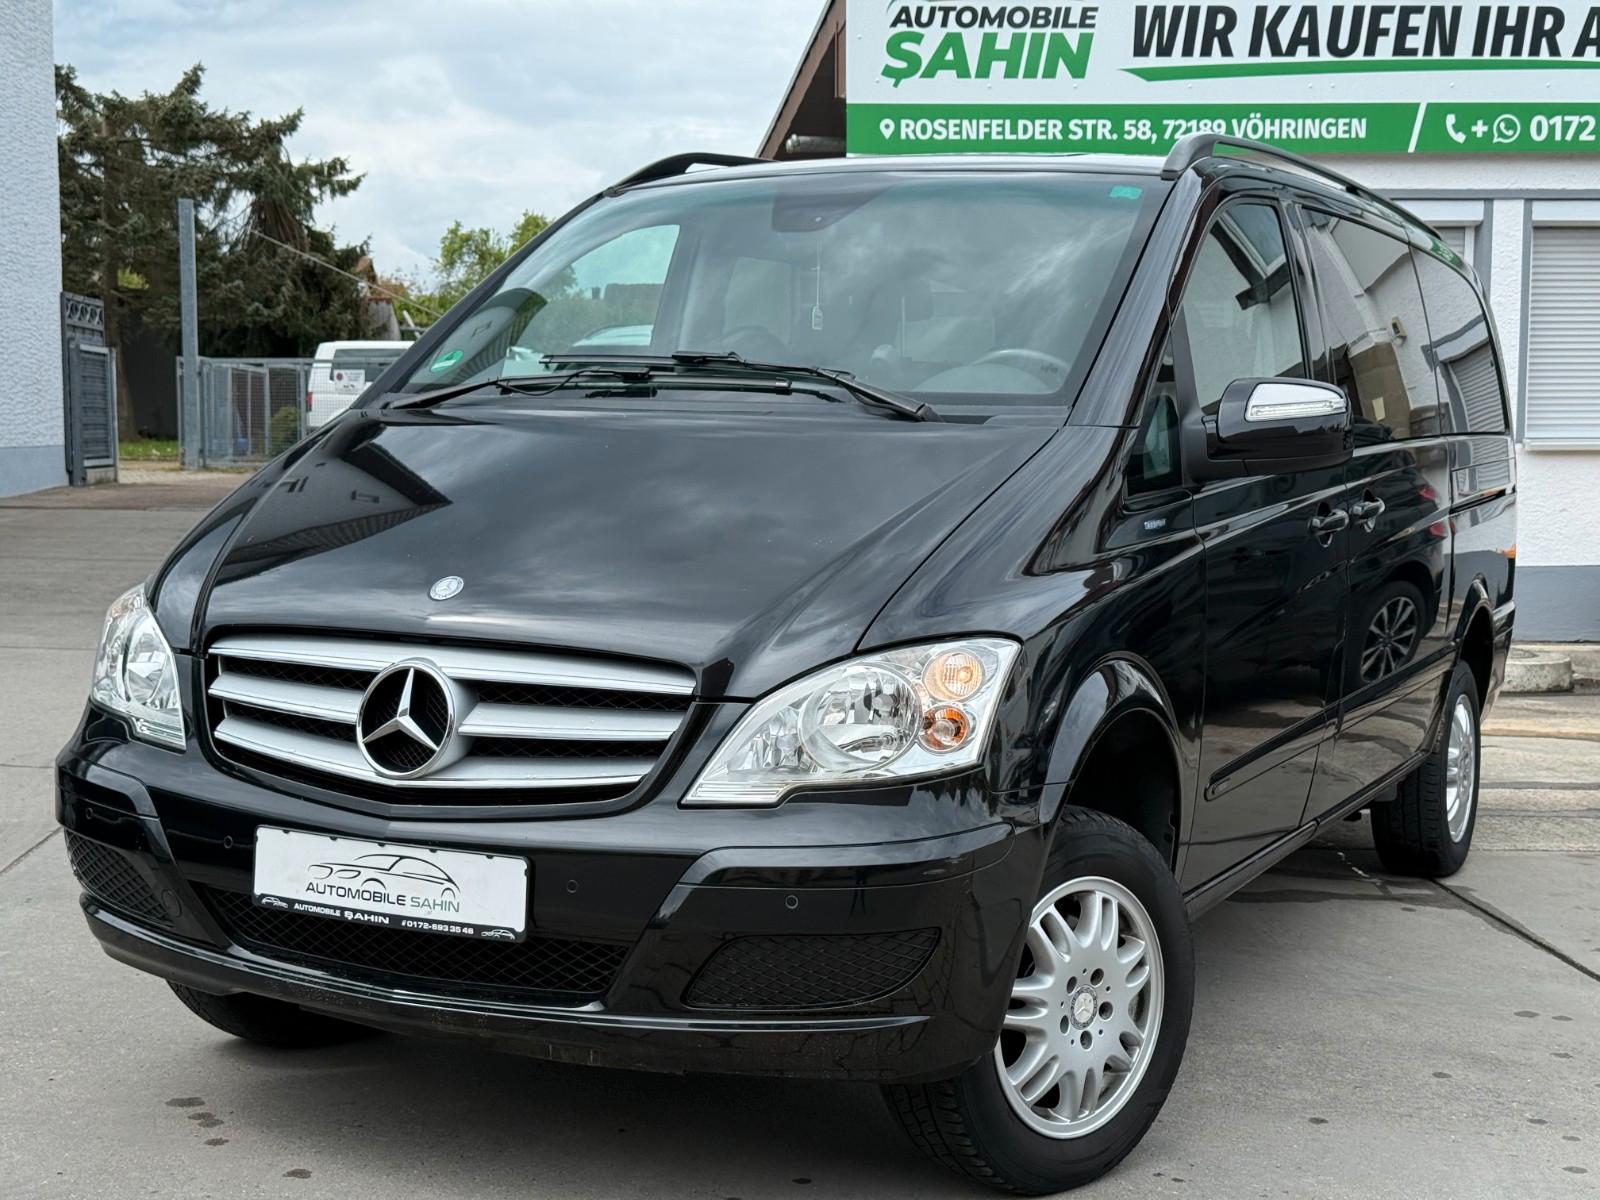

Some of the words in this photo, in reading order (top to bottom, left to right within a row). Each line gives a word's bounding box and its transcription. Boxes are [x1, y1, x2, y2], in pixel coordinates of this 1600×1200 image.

[889, 6, 1099, 29] AUTOMOBILE
[1132, 5, 1238, 58] WIR
[1248, 5, 1463, 58] KAUFEN
[1471, 5, 1566, 58] IHR
[880, 30, 1095, 89] ŞAHIN
[900, 118, 1064, 141] ROSENFELDER
[1067, 118, 1119, 141] STR.
[1122, 118, 1158, 145] 58,
[1162, 117, 1228, 140] 72189
[1231, 111, 1367, 140] VÖHRINGEN
[1529, 114, 1597, 142] 0172
[293, 902, 342, 917] AUTOMOBILE
[305, 881, 407, 906] AUTOMOBILE
[409, 896, 461, 913] SAHIN
